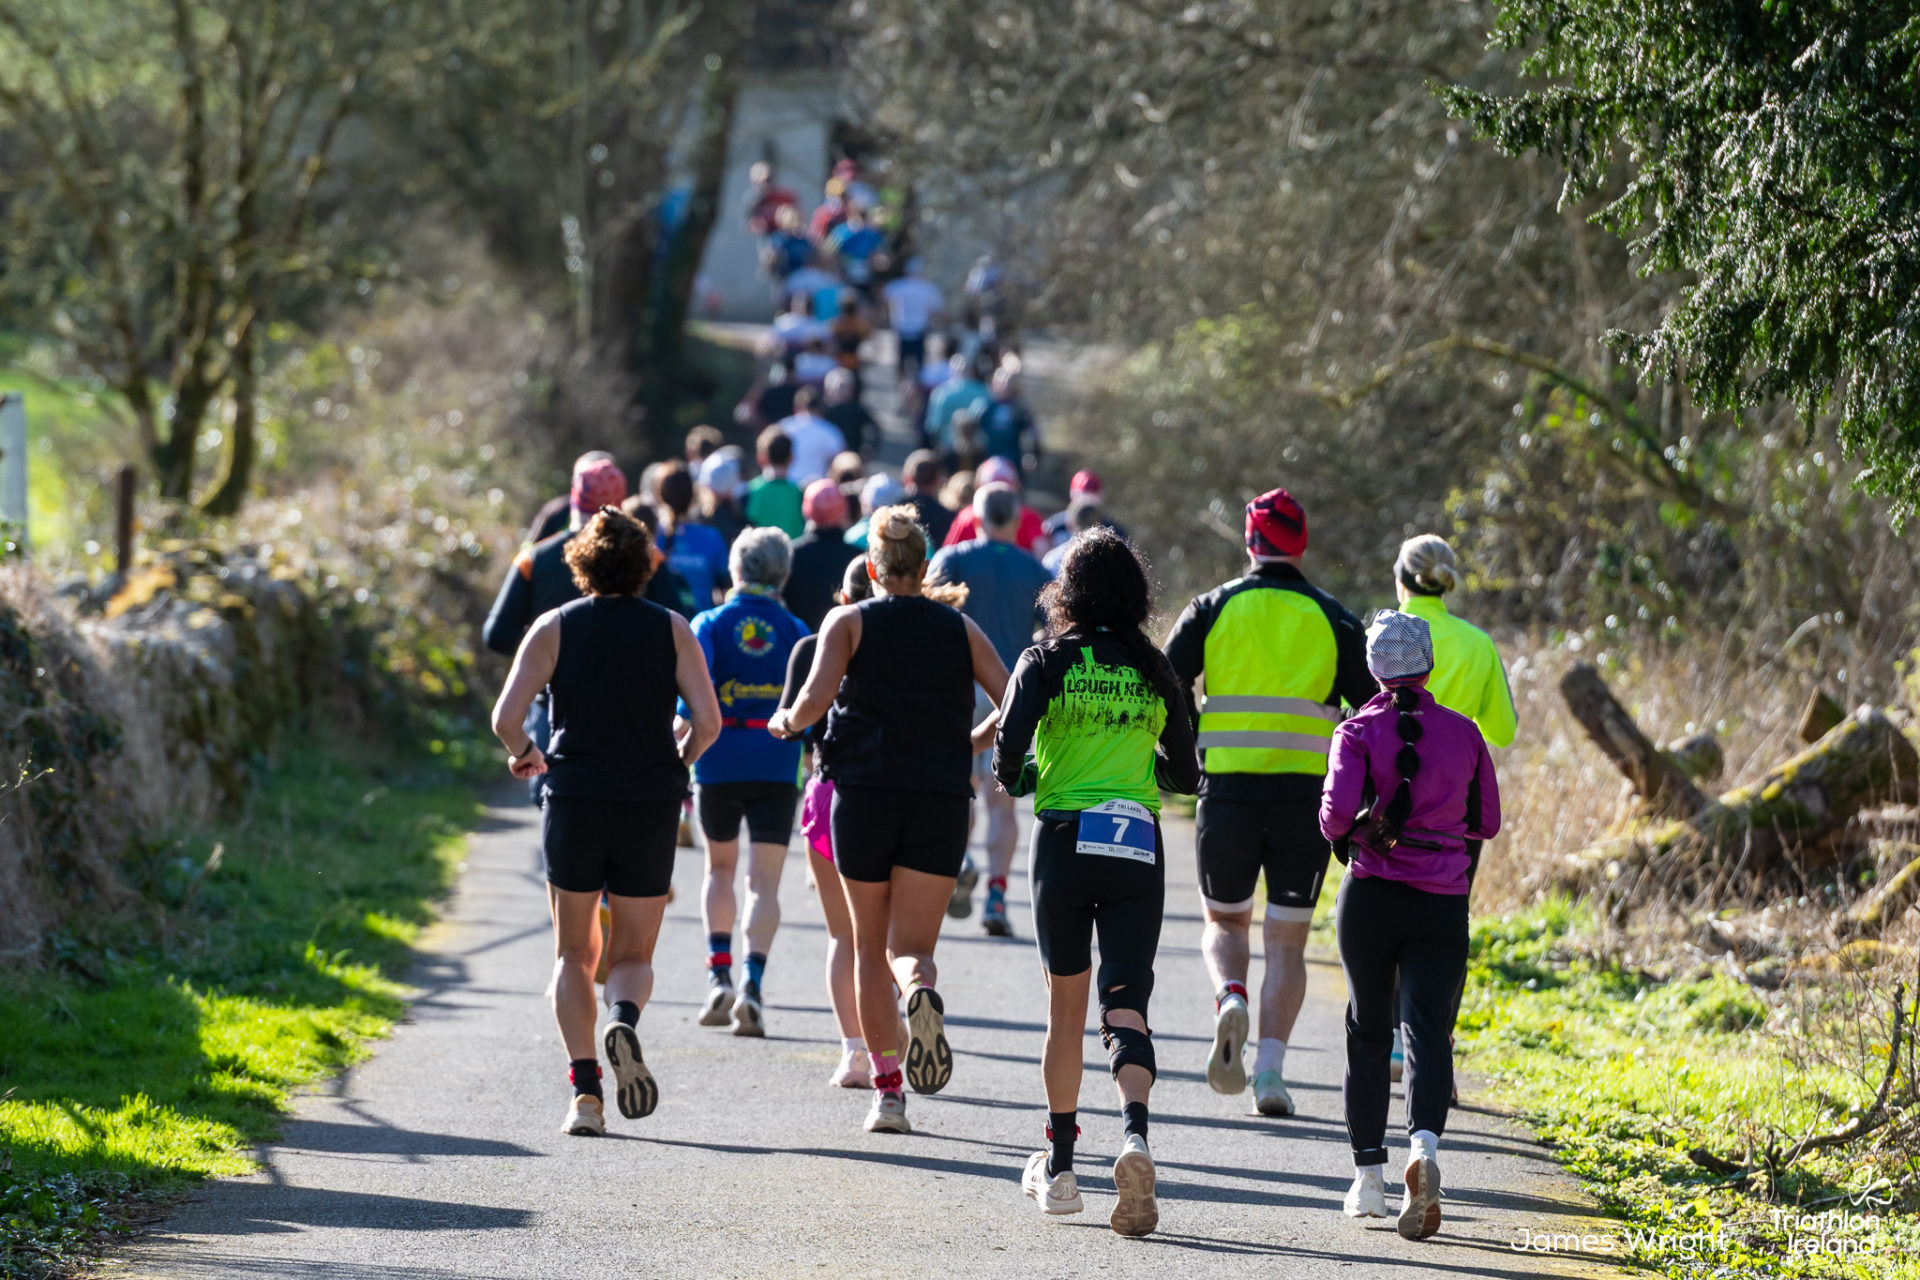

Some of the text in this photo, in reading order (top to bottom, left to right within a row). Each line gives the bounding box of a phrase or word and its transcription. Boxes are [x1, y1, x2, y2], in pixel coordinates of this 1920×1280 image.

[1067, 679, 1121, 696] LOUGH
[1128, 806, 1142, 814] LAKES
[1112, 817, 1130, 843] 7
